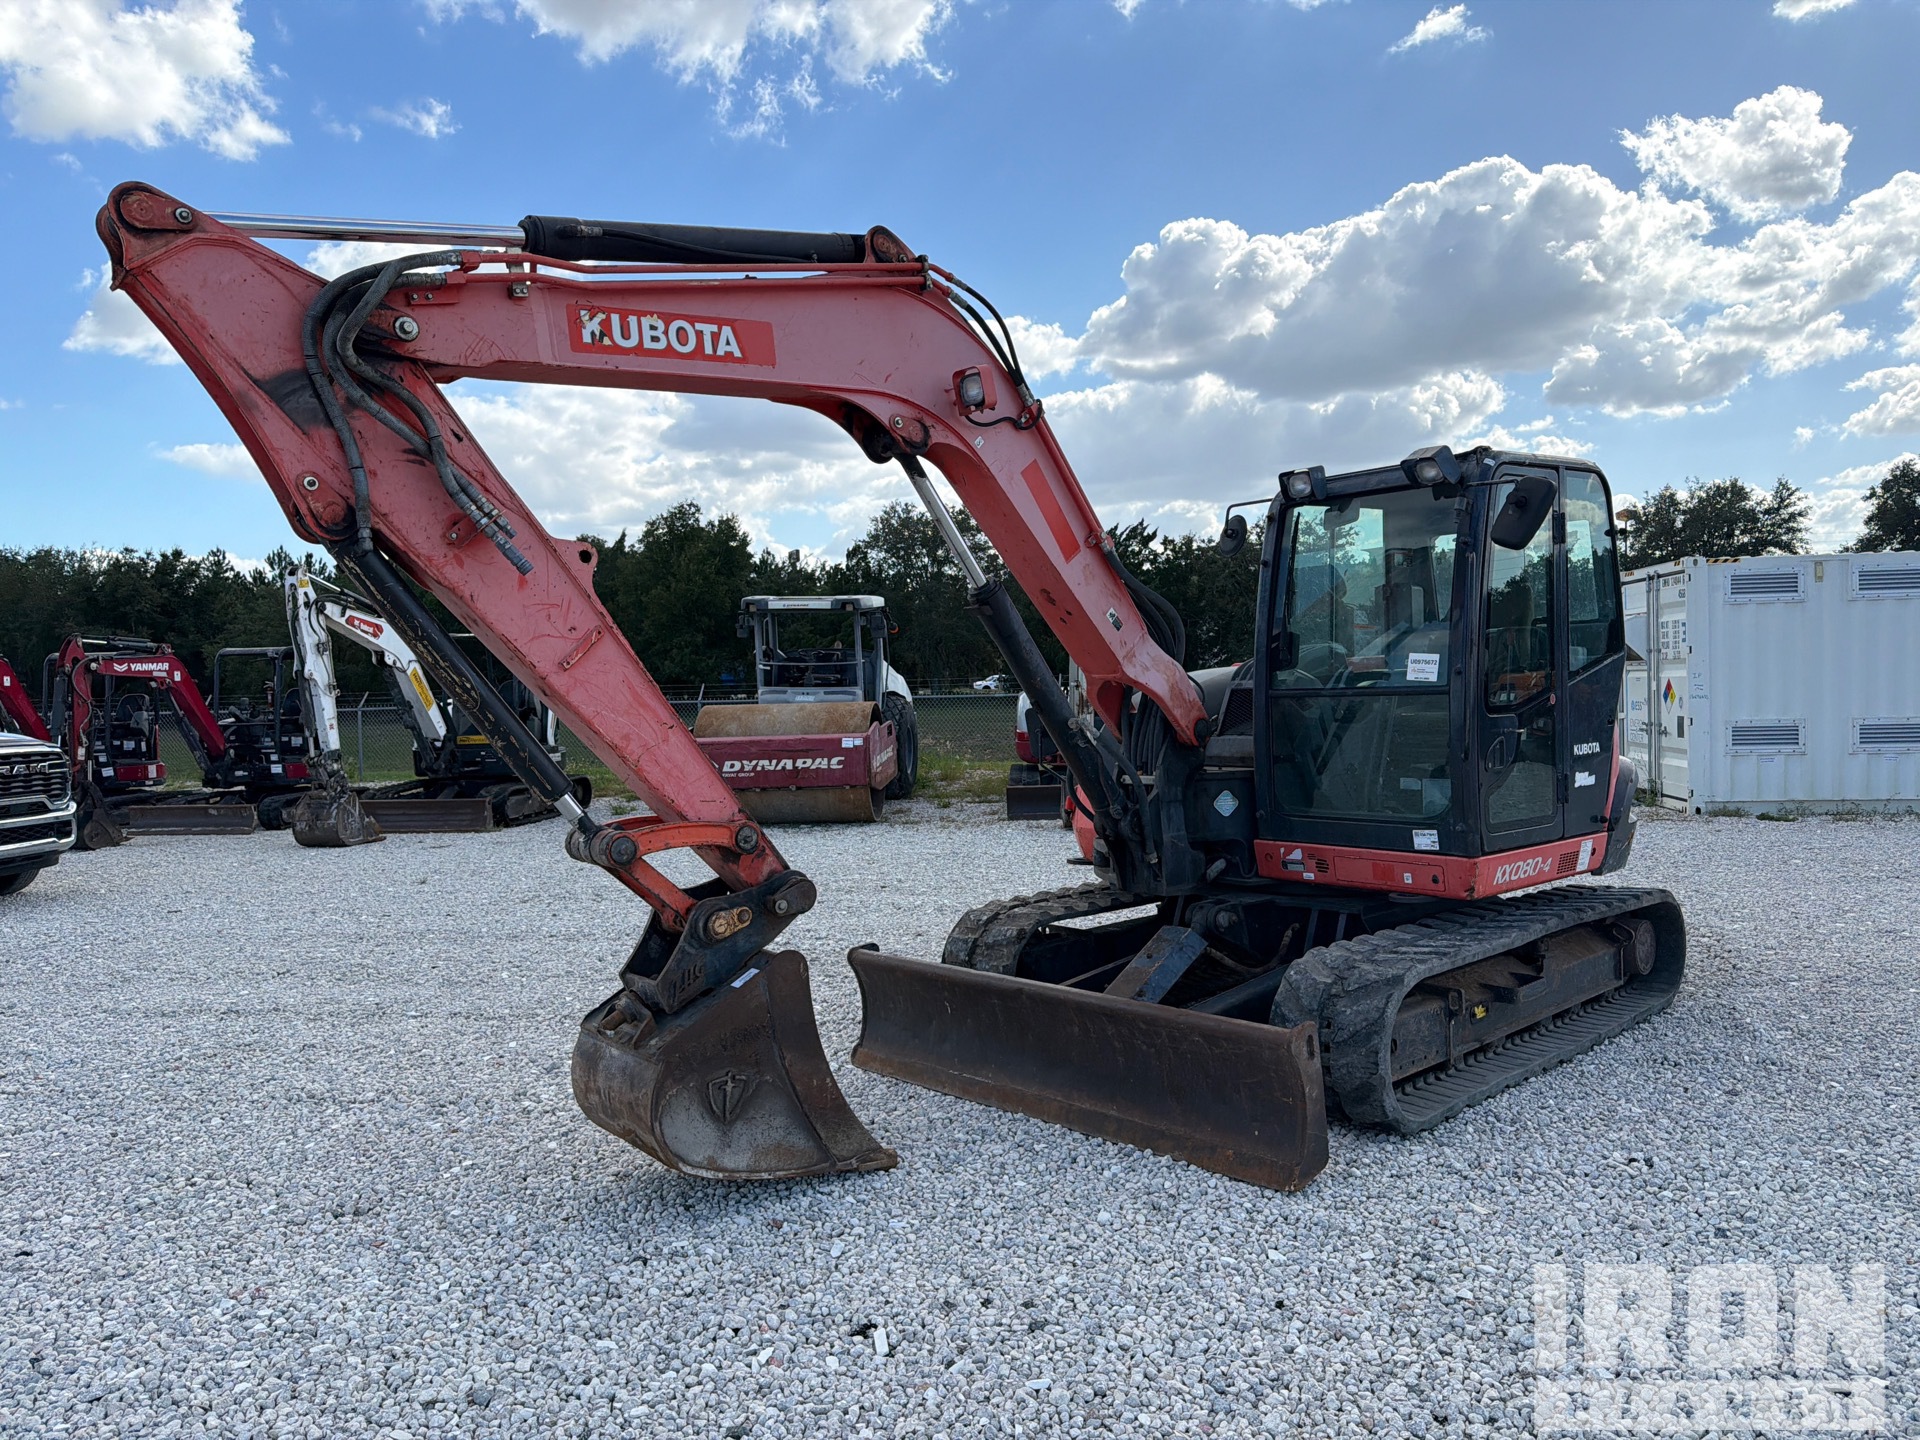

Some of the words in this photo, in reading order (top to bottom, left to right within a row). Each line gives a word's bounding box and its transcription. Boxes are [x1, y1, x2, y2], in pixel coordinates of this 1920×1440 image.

[578, 309, 743, 358] KUBOTA
[130, 662, 170, 672] YANMAR
[1573, 742, 1601, 756] KUBOTA
[722, 756, 845, 772] DYNAPAC
[1493, 856, 1552, 885] KX080-4
